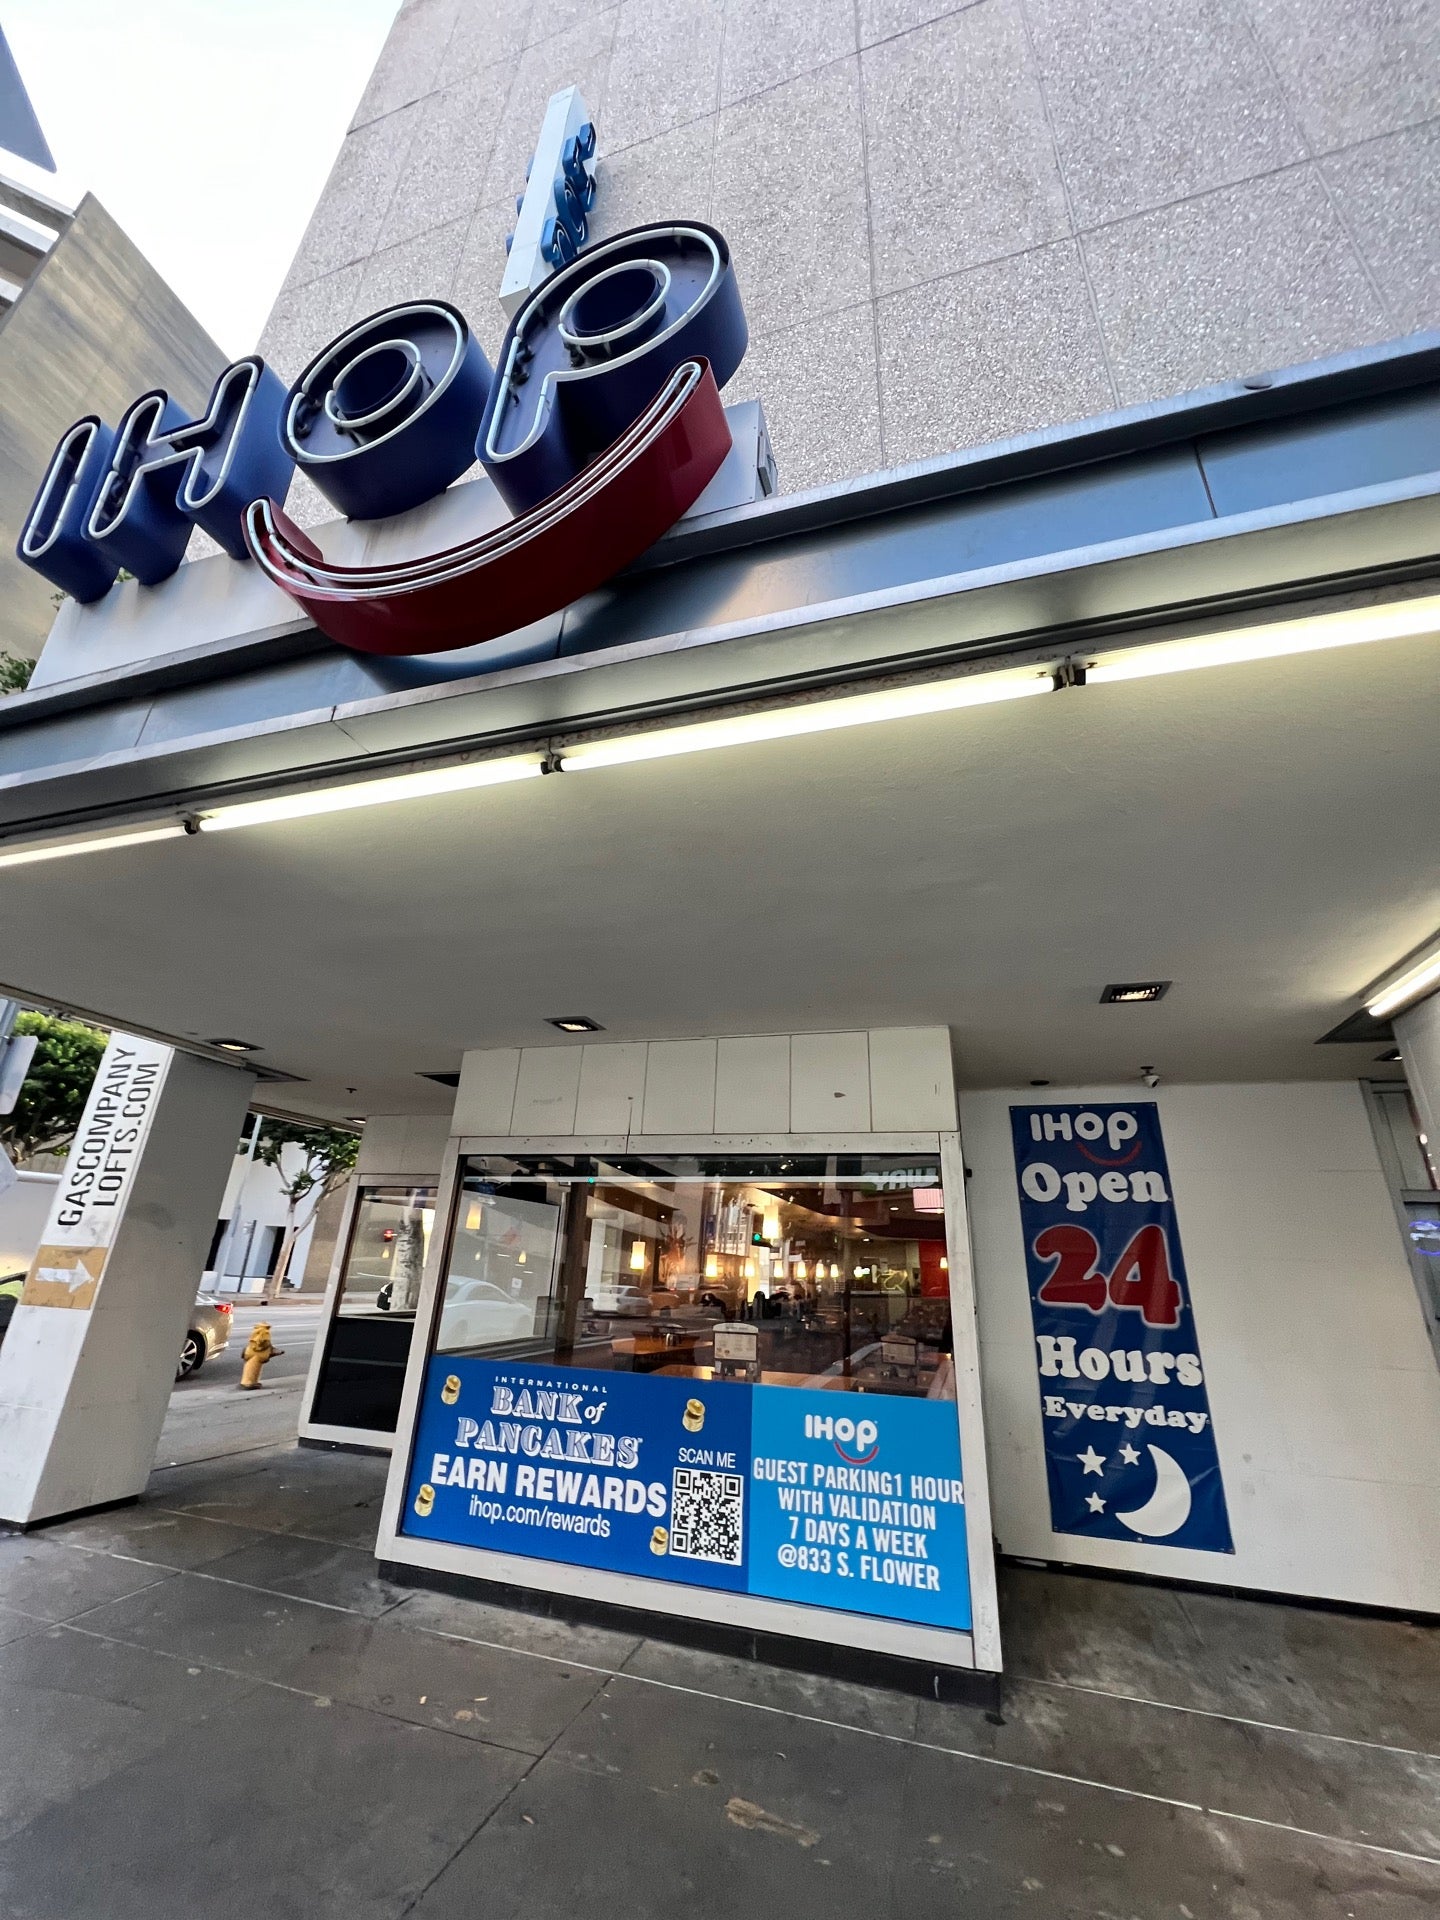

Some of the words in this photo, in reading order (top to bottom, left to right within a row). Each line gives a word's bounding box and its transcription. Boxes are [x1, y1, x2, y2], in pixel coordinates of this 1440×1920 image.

[16, 220, 748, 603] IHOP
[57, 1048, 136, 1226] GASCOMPANY
[92, 1063, 160, 1206] LOFTS.COM
[1030, 1111, 1138, 1151] IHOP
[1021, 1162, 1169, 1212] Open
[1032, 1223, 1183, 1329] 24
[495, 1376, 608, 1393] INTERNATIONAL
[1036, 1336, 1204, 1387] Hours
[490, 1385, 584, 1425] BANK
[584, 1401, 608, 1424] of
[1042, 1395, 1209, 1434] Everyday
[805, 1414, 878, 1452] IHOP
[678, 1448, 714, 1467] SCAN
[716, 1451, 736, 1469] ME
[753, 1457, 807, 1486] GUEST
[911, 1475, 965, 1505] HOUR
[430, 1453, 508, 1494] EARN
[515, 1464, 668, 1518] REWARDS
[778, 1487, 823, 1515] WITH
[828, 1493, 936, 1530] VALIDATION
[468, 1494, 611, 1539] ihop.com/rewards
[789, 1516, 799, 1540] 7
[805, 1518, 850, 1547] DAYS
[855, 1525, 868, 1550] A
[872, 1527, 928, 1559] WEEK
[777, 1543, 831, 1574] @833
[837, 1551, 855, 1578] S.
[860, 1555, 941, 1592] FLOWER
